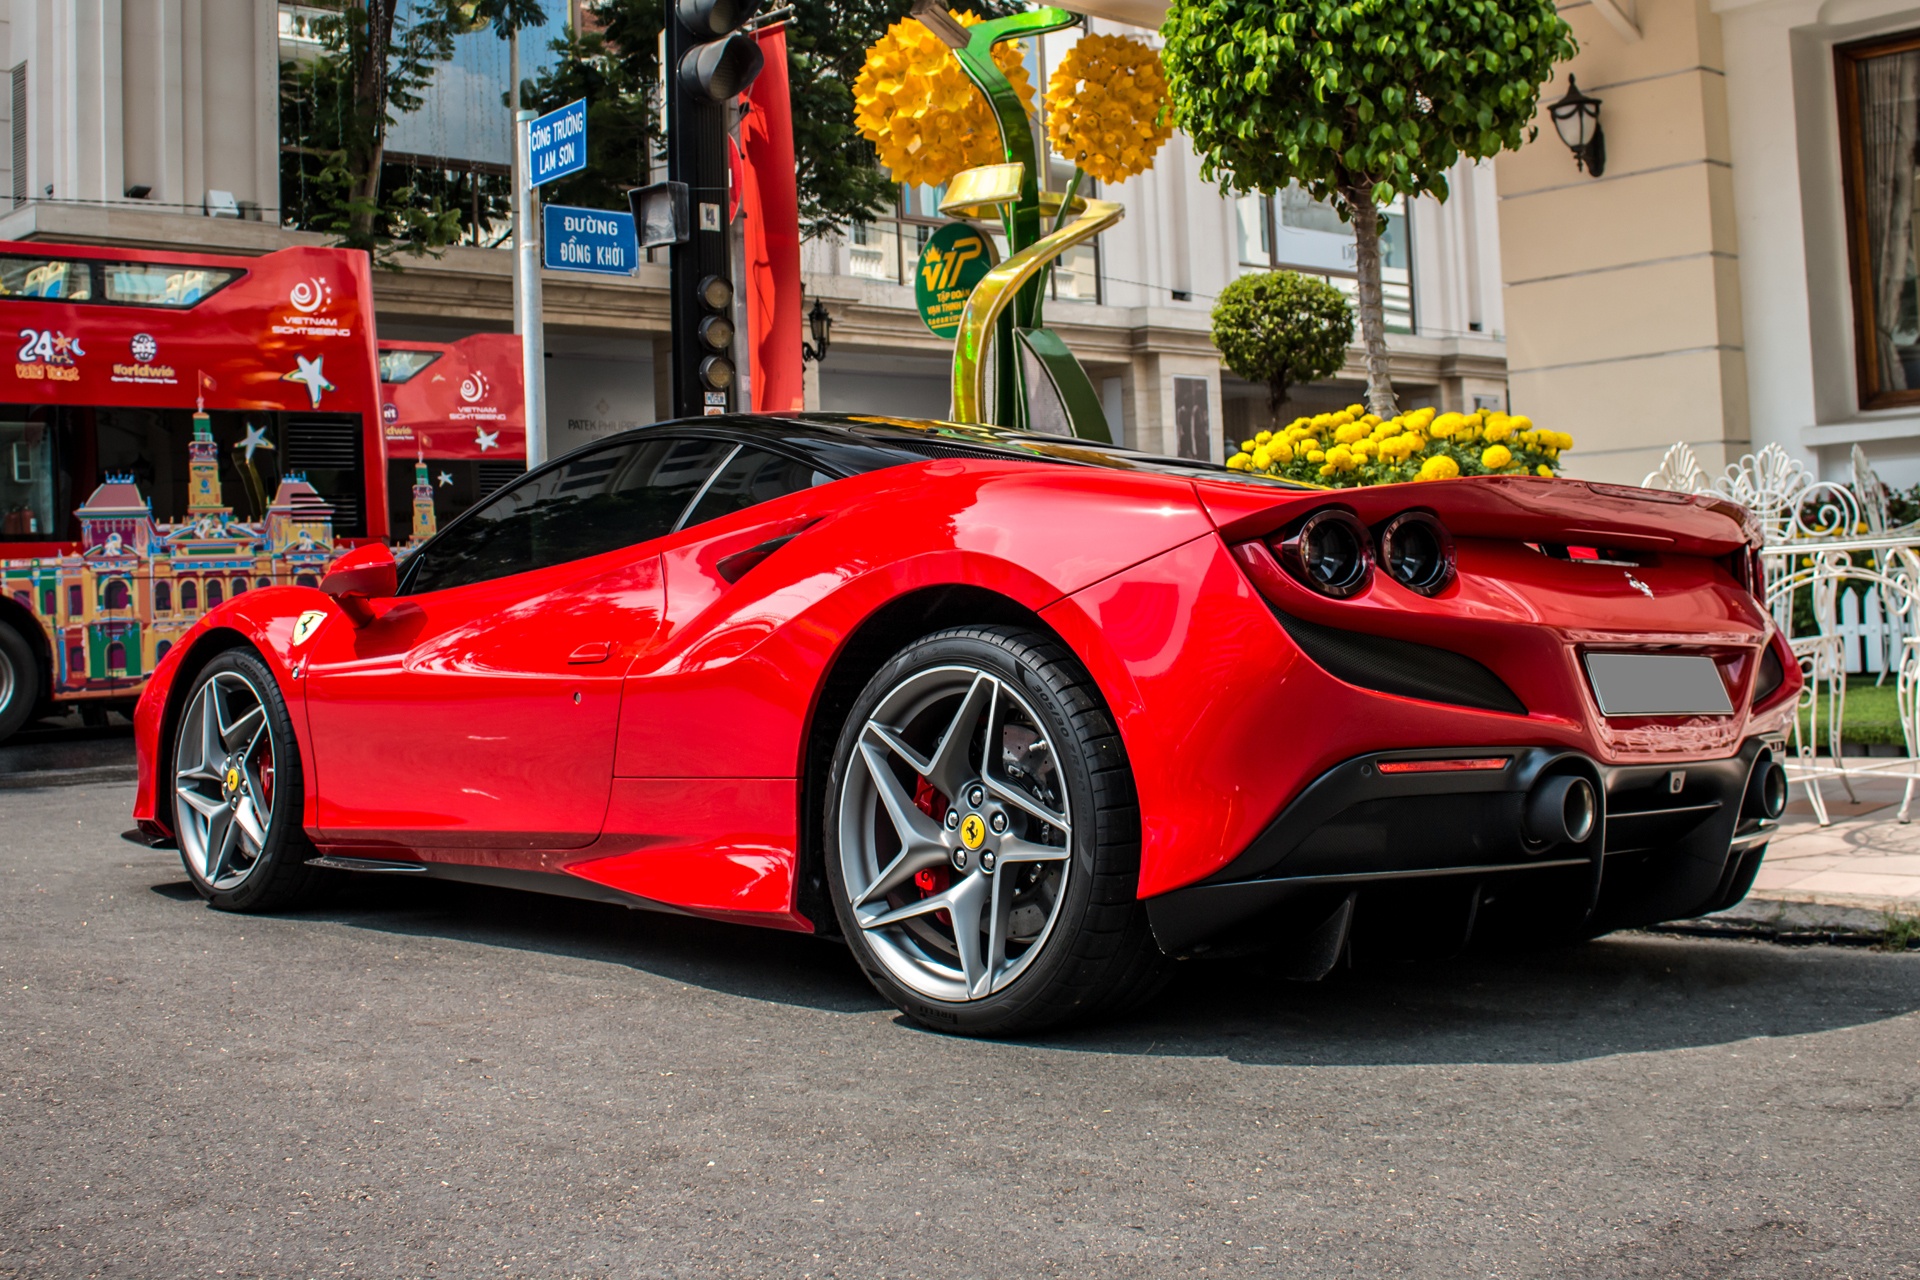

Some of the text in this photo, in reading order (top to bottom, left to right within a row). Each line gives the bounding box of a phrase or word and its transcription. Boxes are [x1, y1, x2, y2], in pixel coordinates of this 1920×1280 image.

[532, 110, 583, 152] CÔNG TRƯỜNG
[540, 142, 574, 175] LAM SƠN
[564, 215, 618, 236] ĐƯỜNG
[560, 235, 624, 267] ĐỒNG KHỞI
[272, 326, 351, 337] SIGHTSEEING
[283, 316, 338, 326] VIETNAM
[19, 330, 53, 362] 24
[568, 419, 637, 432] PATEK PHILIPPE
[1032, 683, 1070, 738] 305/30
